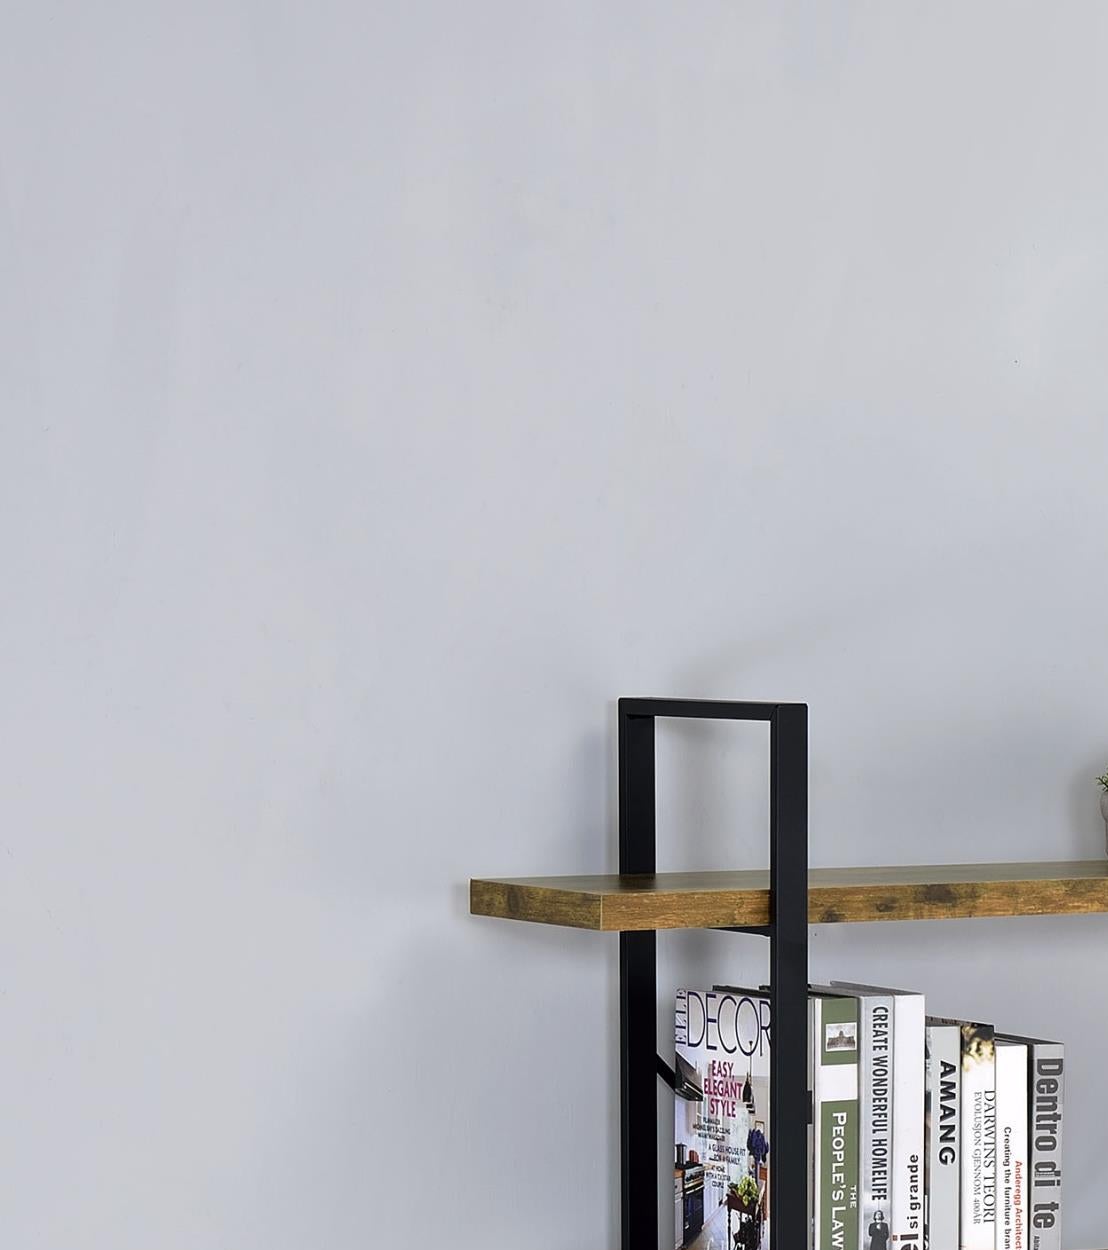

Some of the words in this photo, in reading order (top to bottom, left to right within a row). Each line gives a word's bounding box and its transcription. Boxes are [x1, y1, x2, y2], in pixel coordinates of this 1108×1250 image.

[687, 991, 771, 1056] DECOR
[872, 1005, 888, 1051] CREATE
[704, 1078, 743, 1100] ELEGANT
[710, 1098, 737, 1118] STYLE
[872, 1055, 888, 1134] WONDERFUL
[939, 1060, 956, 1166] AMANG
[1034, 1058, 1064, 1152] Dentro
[973, 1091, 982, 1146] EVOLUSJON
[983, 1090, 996, 1169] DARWINS
[831, 1112, 847, 1201] PEOPLE'S
[871, 1138, 888, 1201] HOMELIFE
[1003, 1126, 1012, 1167] Creating
[907, 1154, 921, 1211] grande
[971, 1148, 982, 1196] GJENNOM
[1004, 1168, 1012, 1184] the
[1014, 1160, 1023, 1206] Anderegg
[1034, 1161, 1061, 1187] di
[907, 1214, 919, 1229] si
[983, 1172, 996, 1223] TEORI
[1004, 1186, 1012, 1226] furniture
[1033, 1201, 1060, 1229] te
